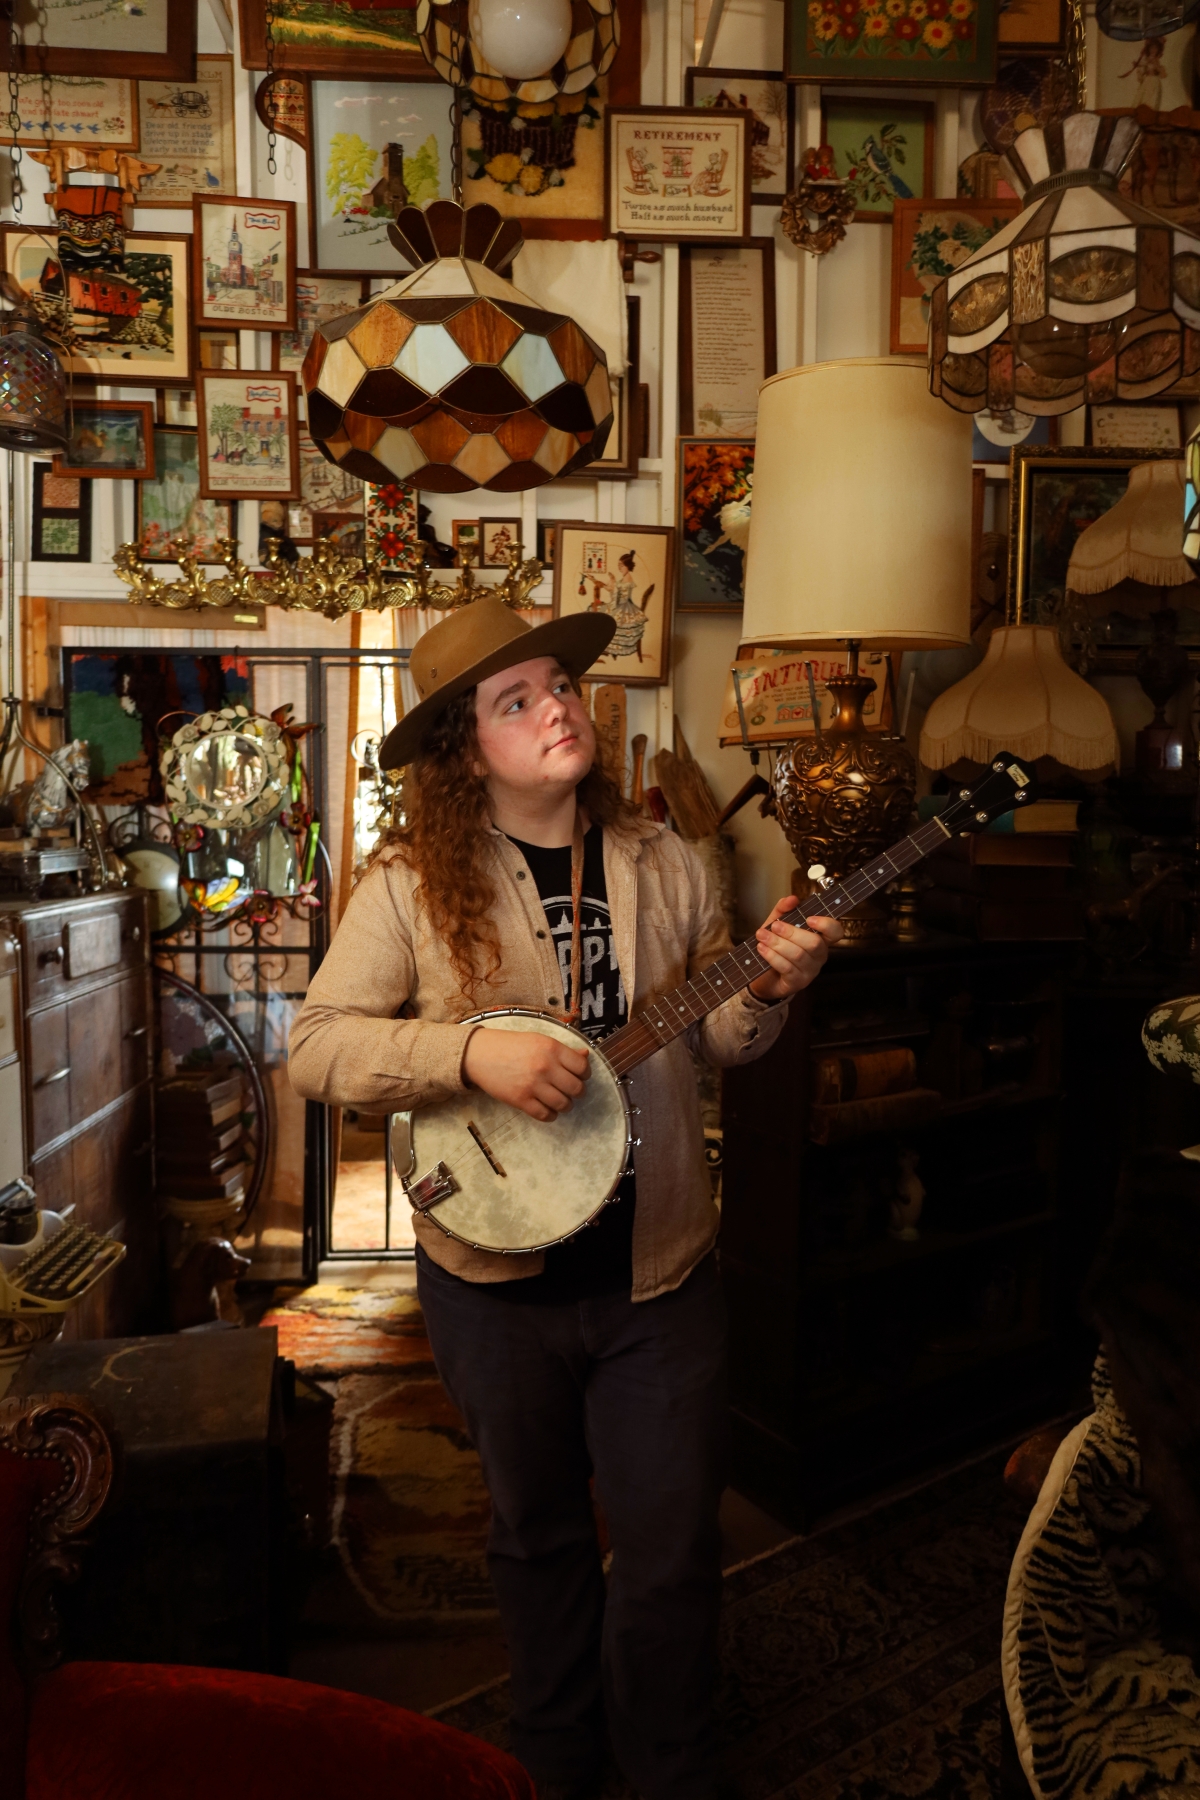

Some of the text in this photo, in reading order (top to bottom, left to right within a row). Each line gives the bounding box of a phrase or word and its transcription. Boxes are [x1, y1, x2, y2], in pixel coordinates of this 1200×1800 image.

[58, 99, 71, 107] too
[54, 109, 69, 117] late
[145, 121, 212, 130] Dear old friends
[144, 129, 213, 139] drive up in state
[633, 130, 721, 142] RETIREMENT
[182, 138, 215, 146] extends
[149, 146, 170, 154] early
[173, 145, 188, 153] and
[621, 200, 652, 211] Twice
[666, 203, 692, 212] much
[693, 203, 733, 212] husband
[630, 211, 651, 220] Half
[666, 213, 692, 221] much
[692, 214, 724, 224] money
[212, 305, 235, 313] OLDE
[741, 659, 866, 703] ANTIQUE
